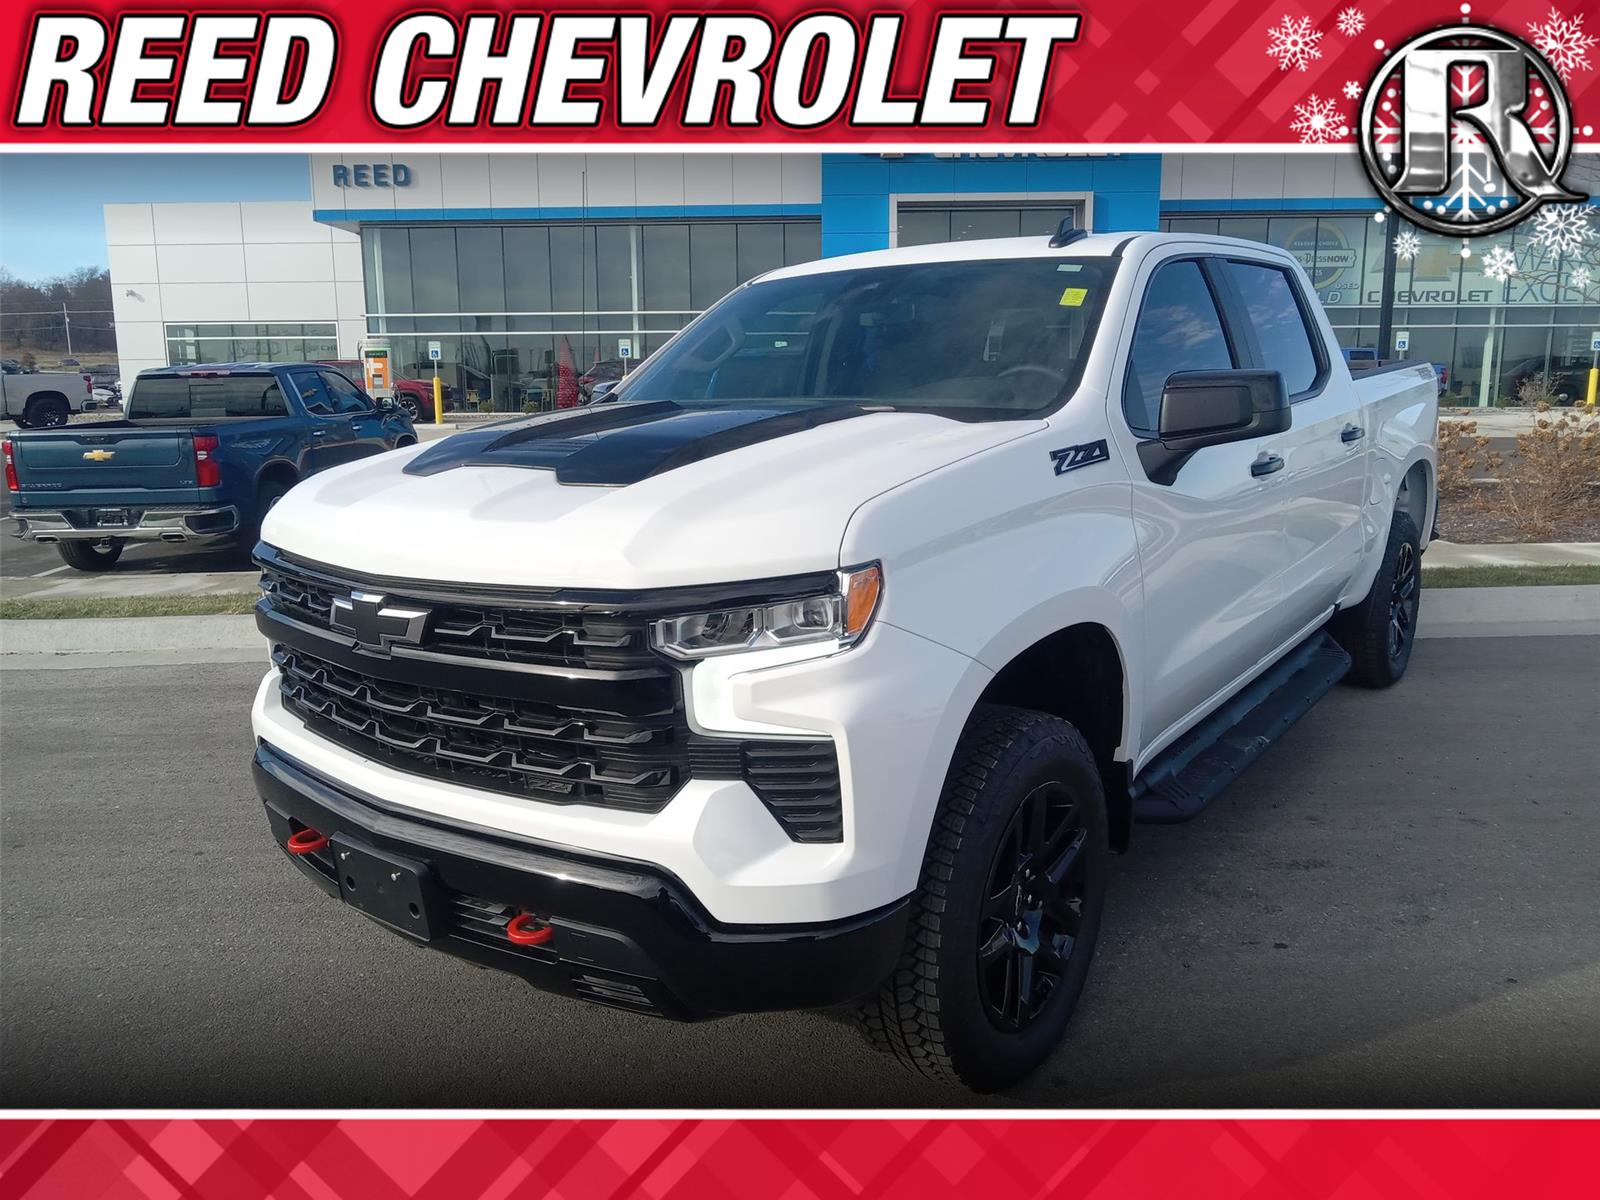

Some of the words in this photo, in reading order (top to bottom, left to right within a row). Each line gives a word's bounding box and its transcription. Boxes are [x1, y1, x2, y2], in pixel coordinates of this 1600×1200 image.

[332, 163, 412, 187] REED
[1367, 290, 1493, 303] CEVROLET
[1502, 270, 1598, 302] EXCE
